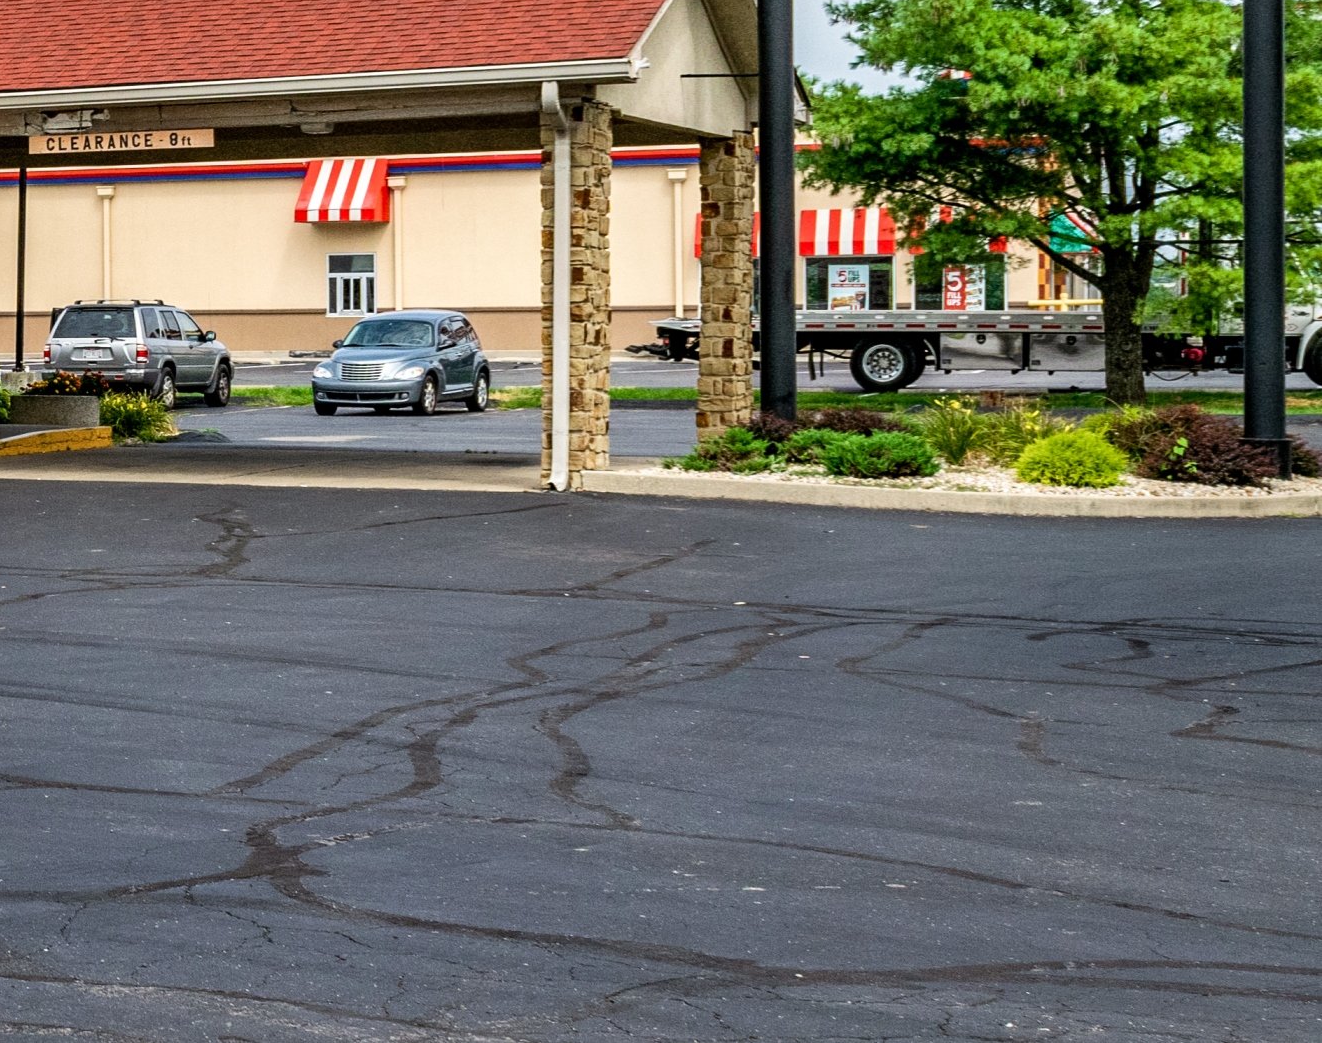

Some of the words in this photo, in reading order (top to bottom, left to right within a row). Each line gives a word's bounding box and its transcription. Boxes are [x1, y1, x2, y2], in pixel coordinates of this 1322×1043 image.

[46, 133, 154, 151] CLEARANCE
[947, 291, 962, 299] FILL
[946, 298, 962, 306] UPS
